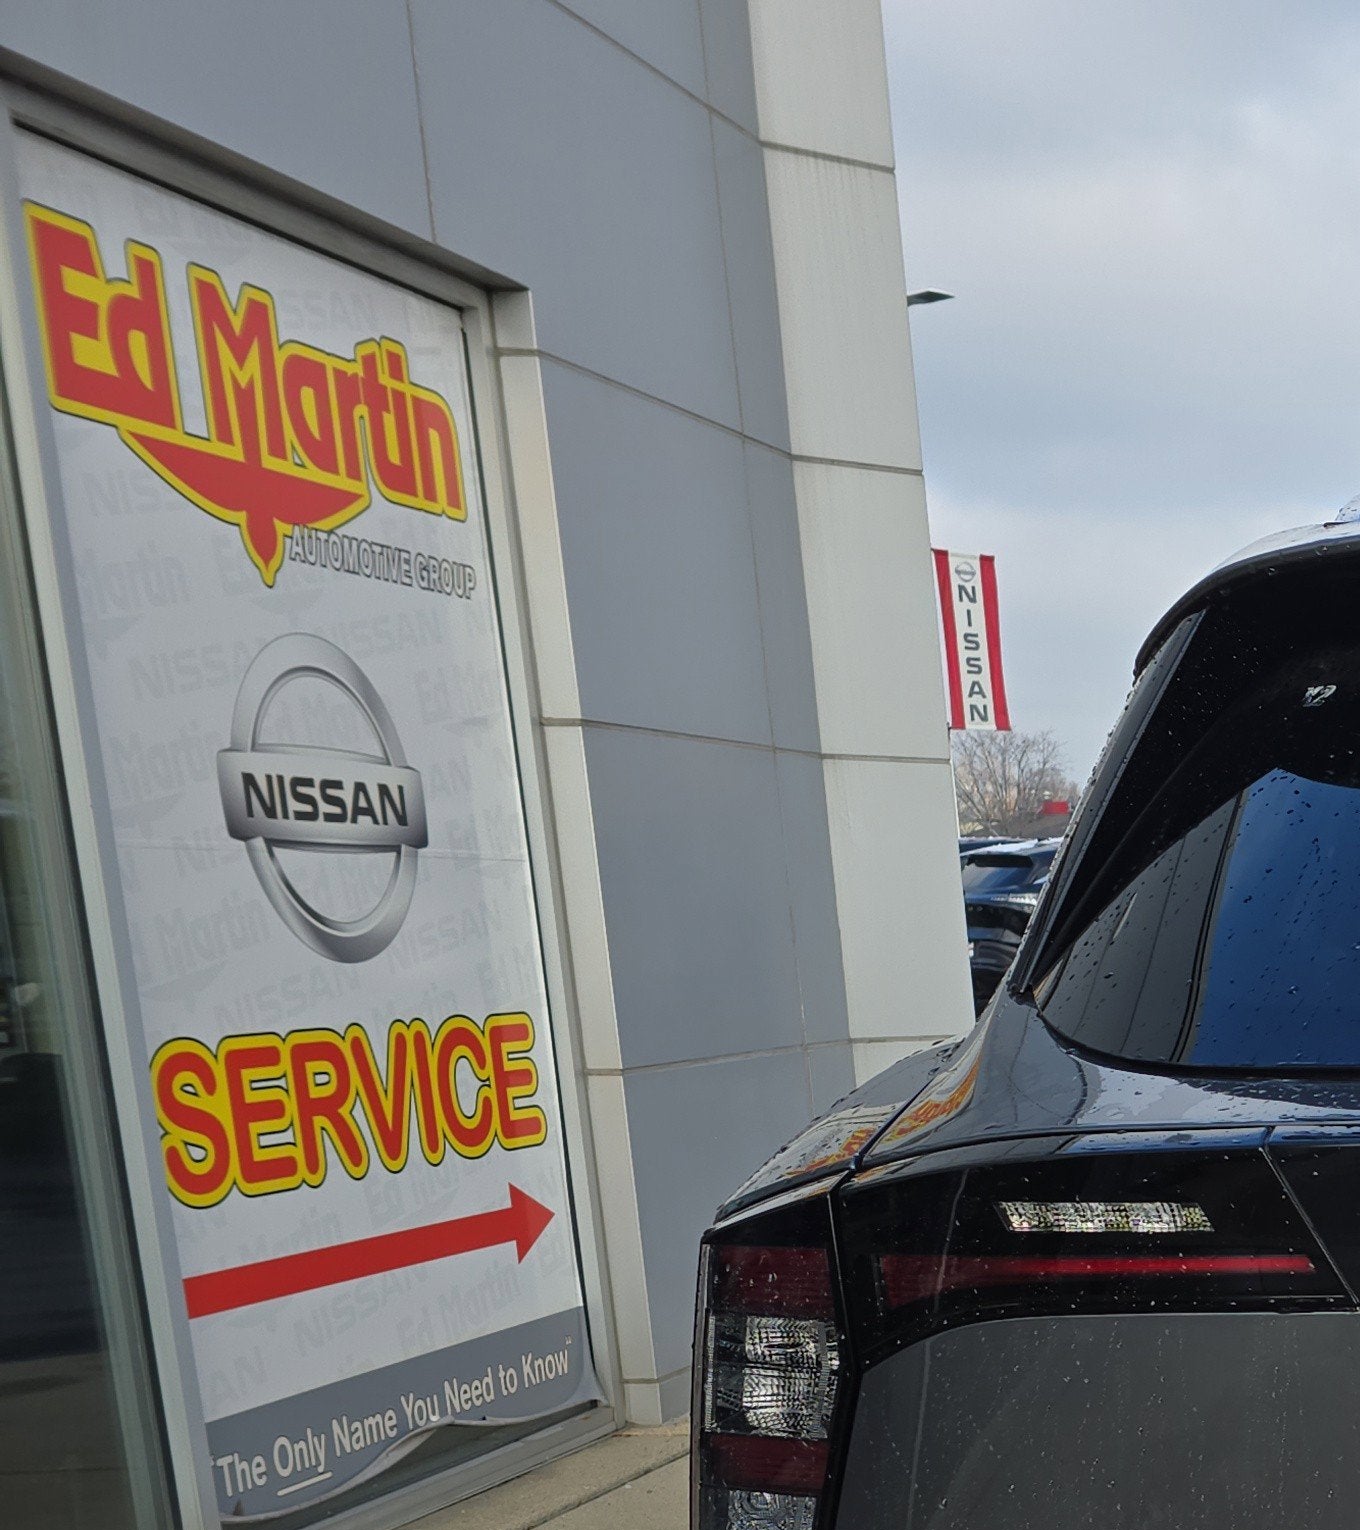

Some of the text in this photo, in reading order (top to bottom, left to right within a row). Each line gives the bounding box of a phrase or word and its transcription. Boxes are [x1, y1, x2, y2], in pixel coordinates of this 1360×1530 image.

[23, 200, 468, 522] Ed Martin
[289, 523, 477, 600] AUTOMOTIVE GROUP
[957, 584, 990, 723] NISSAN
[241, 771, 408, 827] NISSAN
[149, 1011, 548, 1209] SERVICE
[273, 1426, 328, 1476] Only
[331, 1408, 398, 1458] Name
[400, 1392, 440, 1430] You
[443, 1366, 495, 1414] Need
[498, 1364, 518, 1396] to
